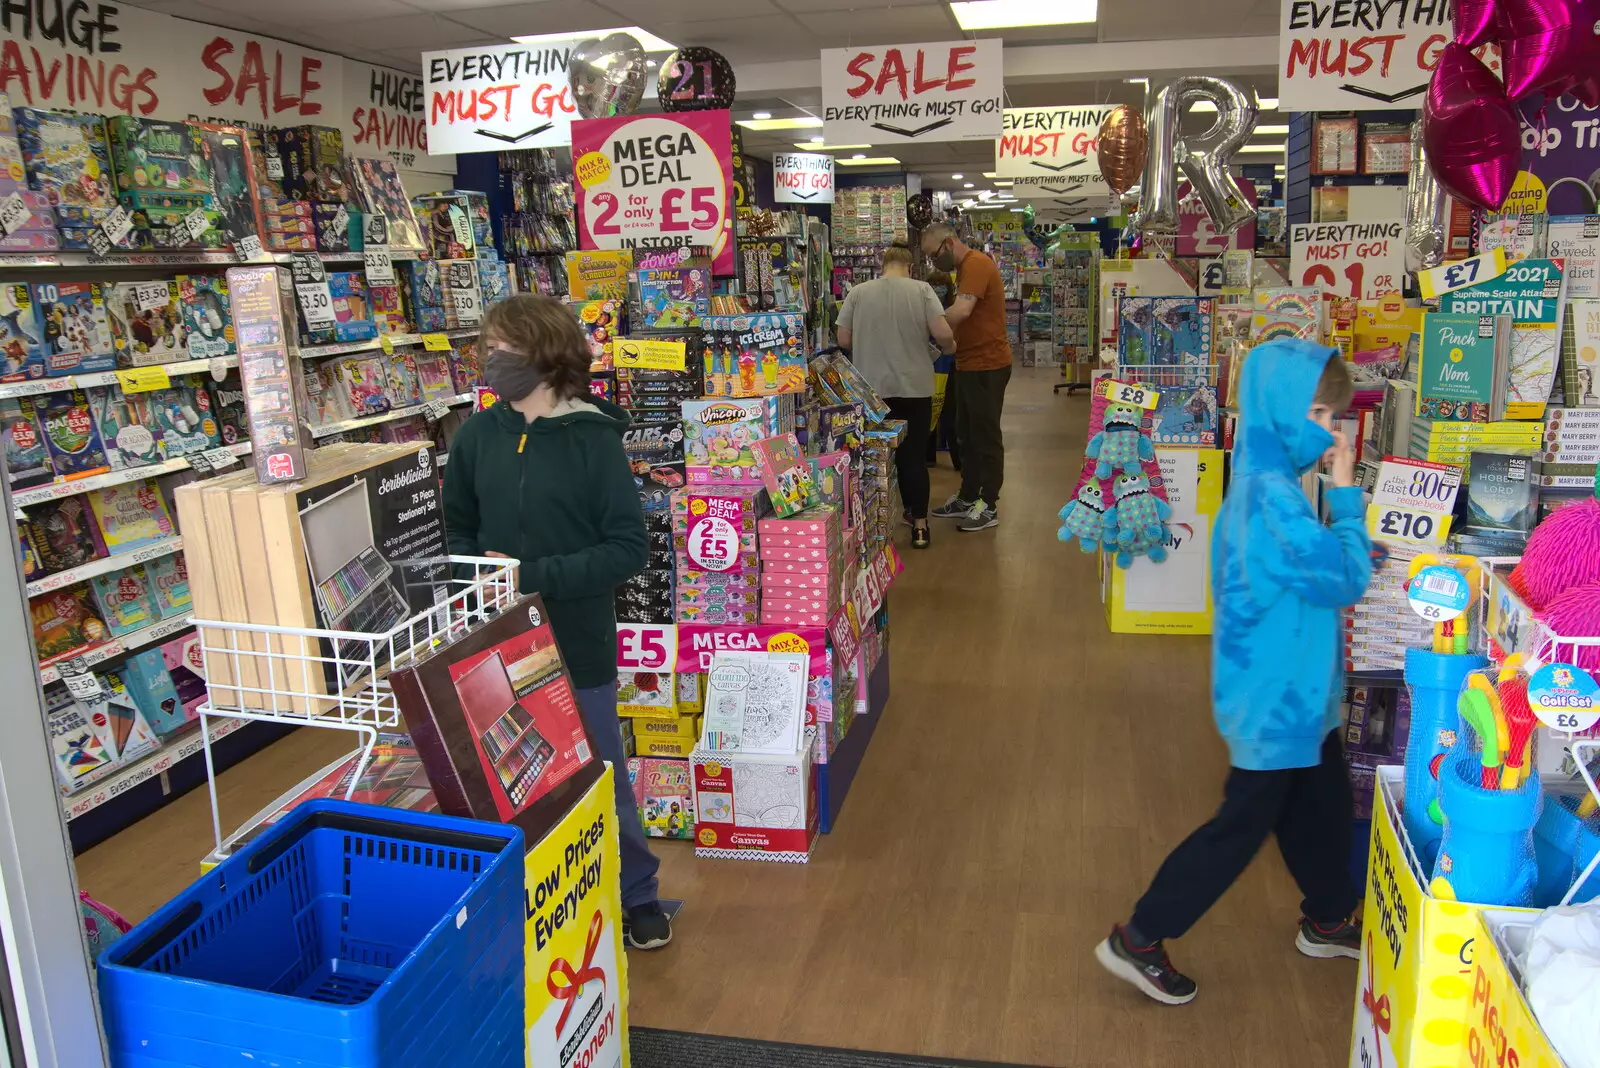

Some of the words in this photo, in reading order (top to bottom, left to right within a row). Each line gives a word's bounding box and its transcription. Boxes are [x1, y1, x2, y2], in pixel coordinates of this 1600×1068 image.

[2, 0, 122, 55] HUGE
[1287, 34, 1406, 78] MUST
[430, 48, 570, 83] EVERYTHIN
[846, 46, 976, 100] SALE
[0, 39, 160, 115] AVINGS
[201, 36, 323, 120] SALE
[670, 60, 721, 100] 21
[370, 69, 424, 107] HUGE
[431, 84, 520, 126] MUST
[825, 103, 921, 121] EVERYTHING
[925, 100, 967, 116] MUST
[970, 97, 999, 113] GO!
[613, 132, 697, 163] MEGA
[999, 132, 1066, 158] MUST
[579, 160, 596, 173] MIX
[596, 157, 604, 165] &
[775, 155, 832, 170] EVERYTHING
[579, 163, 611, 182] MATCH
[620, 159, 692, 188] DEAL
[775, 172, 807, 188] MUST
[811, 172, 833, 188] GO!
[1014, 175, 1066, 185] EVERYTHING
[1068, 174, 1090, 183] MUST
[591, 191, 621, 236] 2
[628, 194, 649, 206] for
[659, 187, 719, 231] £5
[624, 206, 654, 219] only
[977, 222, 993, 231] £10
[1294, 222, 1403, 243] EVERYTHING
[621, 238, 637, 249] IN
[640, 235, 693, 248] STORE
[1306, 242, 1352, 261] MUST
[1355, 240, 1388, 258] GO!
[1550, 240, 1597, 257] 8-week
[1561, 239, 1575, 247] the
[365, 254, 389, 267] £3.50
[647, 271, 679, 281] 3-IN-1
[1373, 275, 1392, 288] OR
[1444, 258, 1481, 288] £7
[1505, 266, 1550, 282] 2021
[1568, 266, 1595, 279] diet
[37, 284, 58, 304] 10
[138, 287, 168, 302] £3.50
[299, 293, 328, 309] £3.50
[1111, 288, 1126, 297] £5
[1453, 290, 1490, 300] Supreme
[1492, 290, 1518, 298] Scale
[1452, 300, 1543, 319] BRITAIN
[739, 333, 753, 345] ICE
[753, 328, 785, 343] CREAM
[1438, 326, 1477, 347] Pinch
[1439, 362, 1471, 382] Nom
[1121, 387, 1145, 404] £8
[701, 407, 746, 425] Unicorn
[621, 426, 663, 444] CARS
[1200, 432, 1215, 440] 75
[419, 455, 429, 464] £10
[378, 466, 433, 495] Scribblicious
[1381, 479, 1408, 496] fast
[1391, 475, 1406, 484] the
[1409, 470, 1452, 502] 800
[411, 493, 419, 505] 75
[419, 489, 435, 502] Piece
[1484, 485, 1514, 495] LORD
[398, 504, 427, 524] Stationery
[427, 499, 437, 511] Set
[708, 498, 739, 511] MEGA
[1396, 497, 1424, 508] recipe
[1424, 499, 1446, 511] book
[709, 508, 736, 519] DEAL
[700, 520, 714, 538] 2
[1381, 511, 1433, 539] £10
[132, 545, 173, 562] EVERYTHING
[700, 539, 728, 559] £5
[43, 577, 62, 589] MUST
[64, 574, 76, 583] GO
[1423, 605, 1440, 618] £6
[149, 619, 188, 639] EVERYTHING
[616, 628, 667, 668] £5
[693, 632, 762, 650] MEGA
[770, 639, 789, 651] MIX
[791, 637, 800, 645] &
[68, 678, 96, 692] £3.50
[1540, 694, 1567, 707] Golf
[1568, 694, 1592, 708] Set
[49, 712, 80, 729] PAPER
[50, 718, 88, 739] PLANES
[1556, 714, 1579, 727] £6
[110, 767, 153, 796] EVERYTHING
[152, 756, 171, 772] MUST
[72, 797, 91, 816] MUST
[94, 791, 107, 803] GO
[730, 836, 770, 846] Canvas
[525, 863, 560, 921] Low
[564, 812, 604, 879] Prices
[1374, 810, 1385, 868] Low
[1384, 849, 1408, 934] Prices
[534, 852, 602, 952] Everyday
[1371, 855, 1402, 970] Everyday
